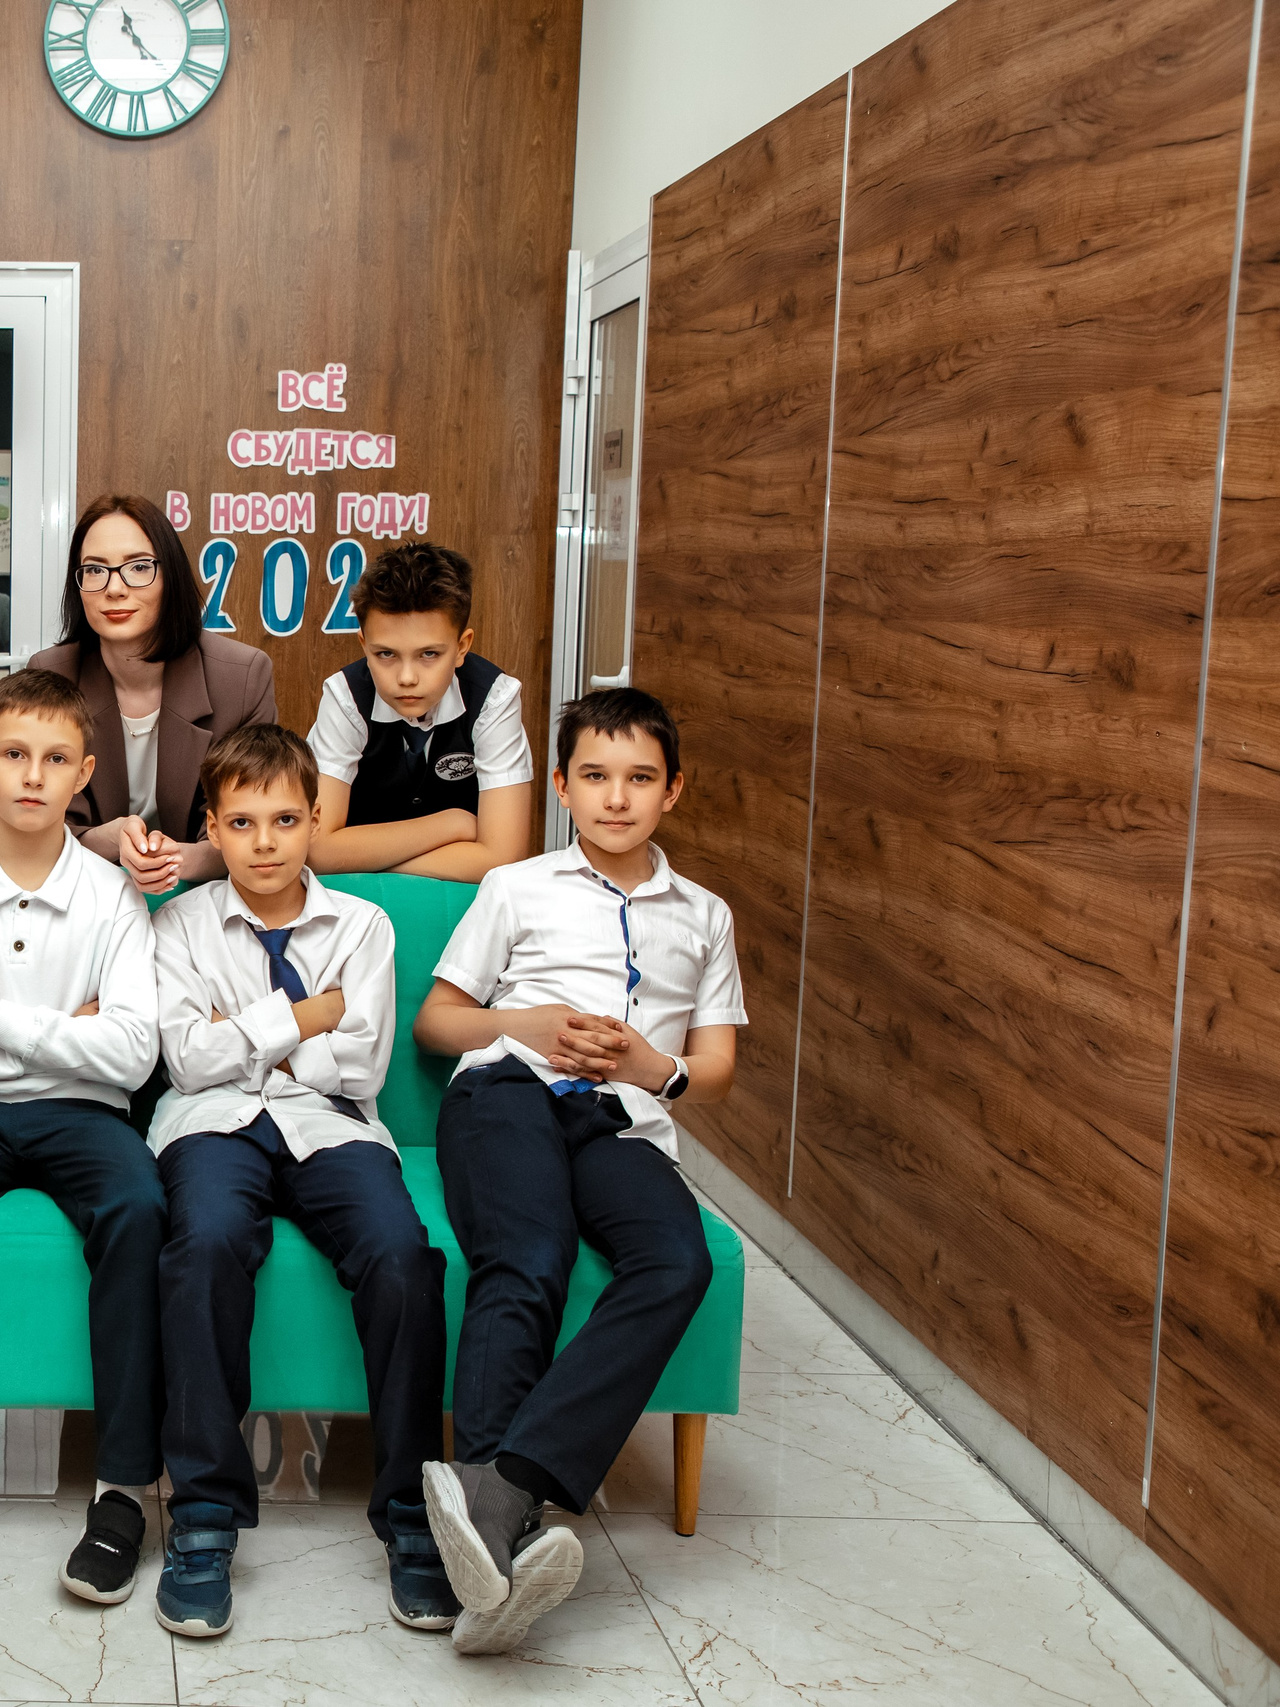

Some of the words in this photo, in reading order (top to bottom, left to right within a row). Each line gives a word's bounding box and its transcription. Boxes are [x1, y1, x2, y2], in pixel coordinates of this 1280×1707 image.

[280, 365, 345, 410] ВСЁ
[229, 431, 394, 473] СБУДЕТСЯ
[169, 492, 190, 529] В
[212, 494, 314, 532] НОВОМ
[338, 494, 428, 537] ГОДУ!
[200, 539, 366, 634] 202
